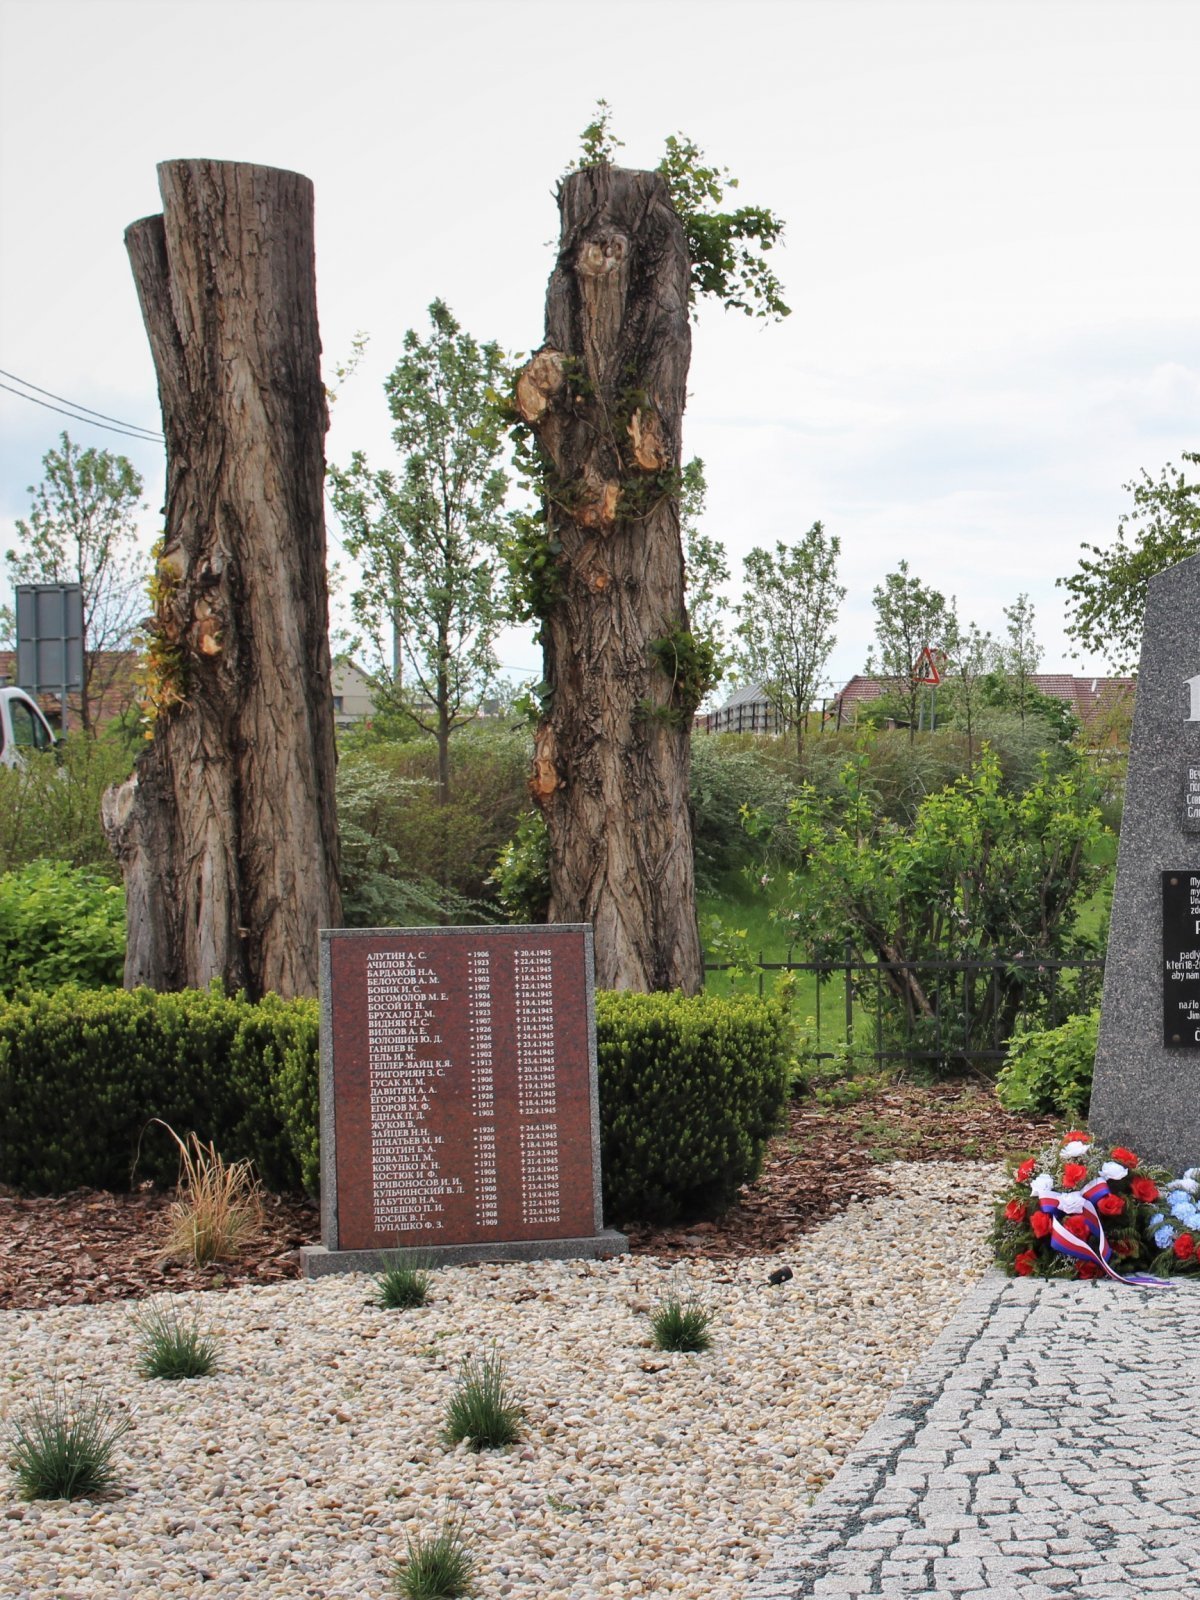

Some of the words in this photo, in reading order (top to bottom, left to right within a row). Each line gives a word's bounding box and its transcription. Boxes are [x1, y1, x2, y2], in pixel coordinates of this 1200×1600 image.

[1190, 877, 1200, 887] My
[1190, 888, 1200, 897] my
[367, 969, 416, 977] БАРДАКОВ
[1172, 971, 1184, 981] aby
[368, 986, 399, 994] БОБИК
[368, 1002, 401, 1010] БОСОЙ
[368, 1011, 411, 1019] БРУХАЛО
[369, 1020, 407, 1028] ВИДНЯК
[369, 1028, 406, 1036] ВИЛКОВ
[369, 1036, 418, 1044] ВОЛОШИН
[369, 1045, 405, 1053] ГАНИЕВ
[370, 1088, 415, 1096] ДАВИТЯН
[371, 1096, 406, 1104] ЕГОРОВ
[371, 1104, 406, 1112] ЕГОРОВ
[371, 1121, 405, 1129] ЖУКОВ
[372, 1129, 408, 1137] ЗАЙЦЕВ
[372, 1138, 420, 1146] ИГНАТЬЕВ
[372, 1146, 415, 1154] ИЛЮТИН
[372, 1155, 410, 1163] КОВАЛЬ
[373, 1163, 418, 1172] КОКУНКО
[373, 1172, 414, 1180] КОСТЮК
[373, 1198, 417, 1206] ЛАБУТОВ
[374, 1206, 421, 1214] ЛЕМЕШКО
[374, 1215, 407, 1223] ЛОСИК
[374, 1223, 422, 1231] ЛУПАШКО
